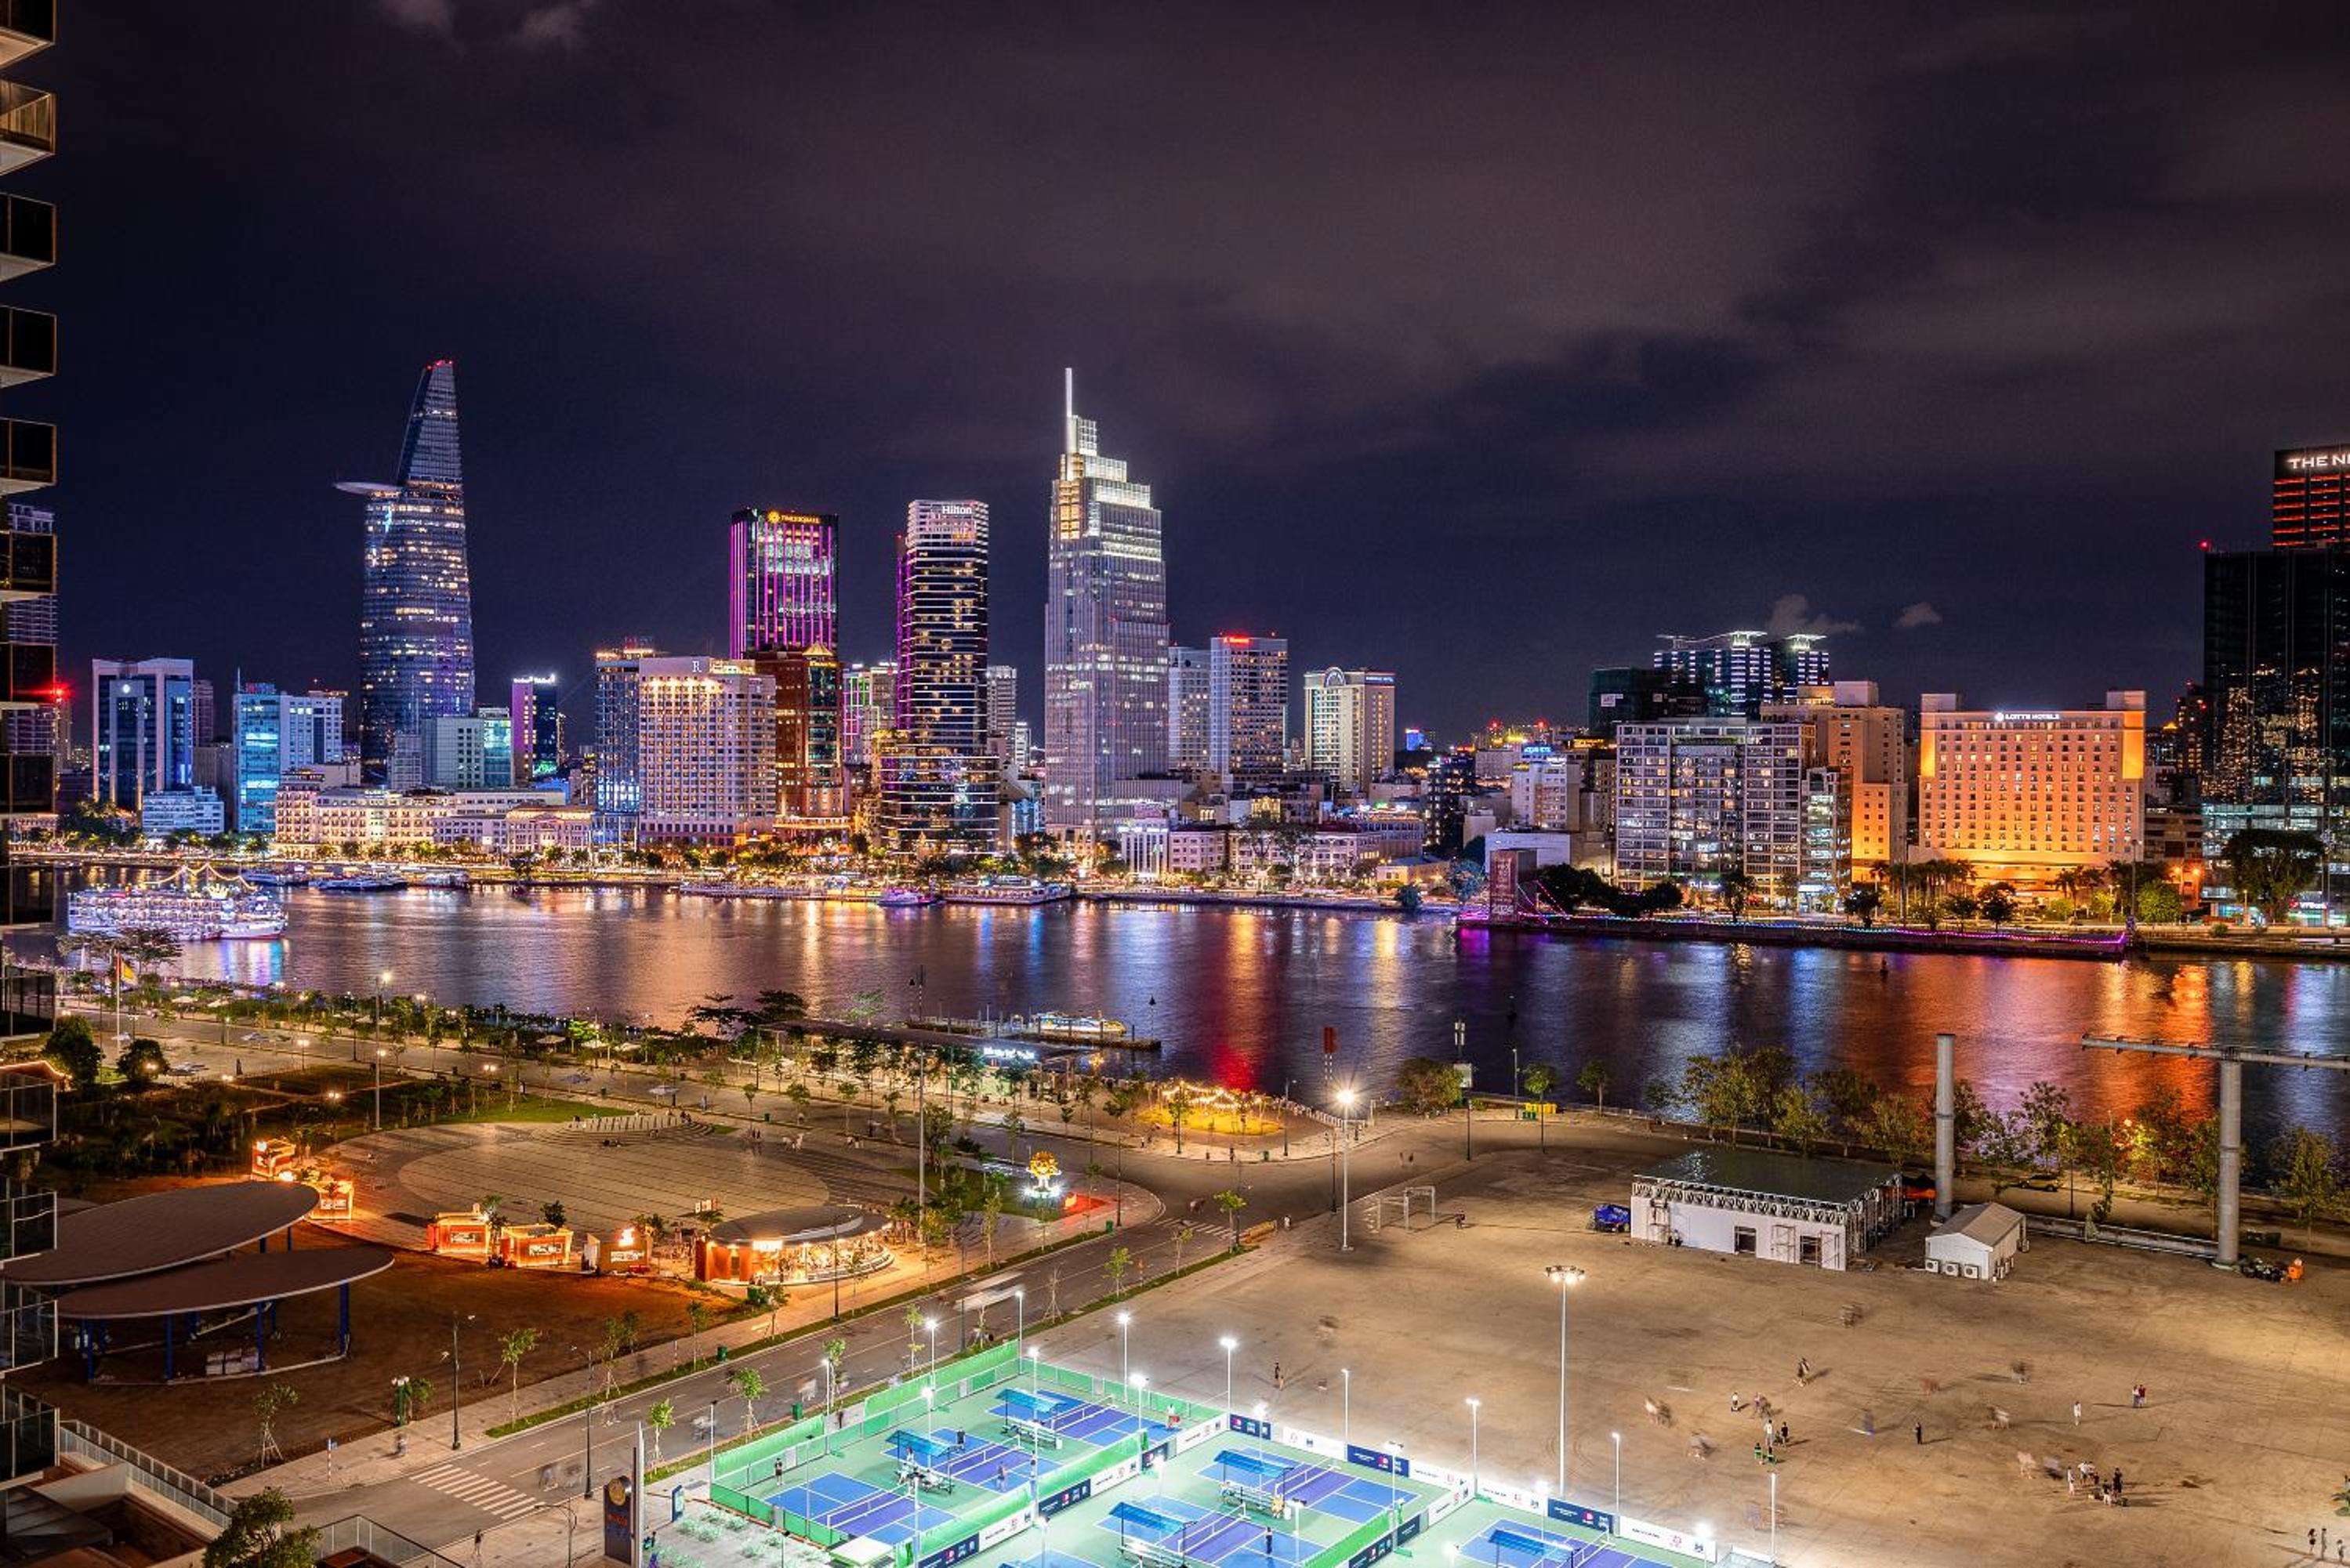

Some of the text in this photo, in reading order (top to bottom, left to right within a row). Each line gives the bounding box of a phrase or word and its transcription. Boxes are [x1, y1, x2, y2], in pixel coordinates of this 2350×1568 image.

[2287, 453, 2350, 469] THE N
[942, 505, 972, 514] Hilton
[692, 660, 702, 673] R
